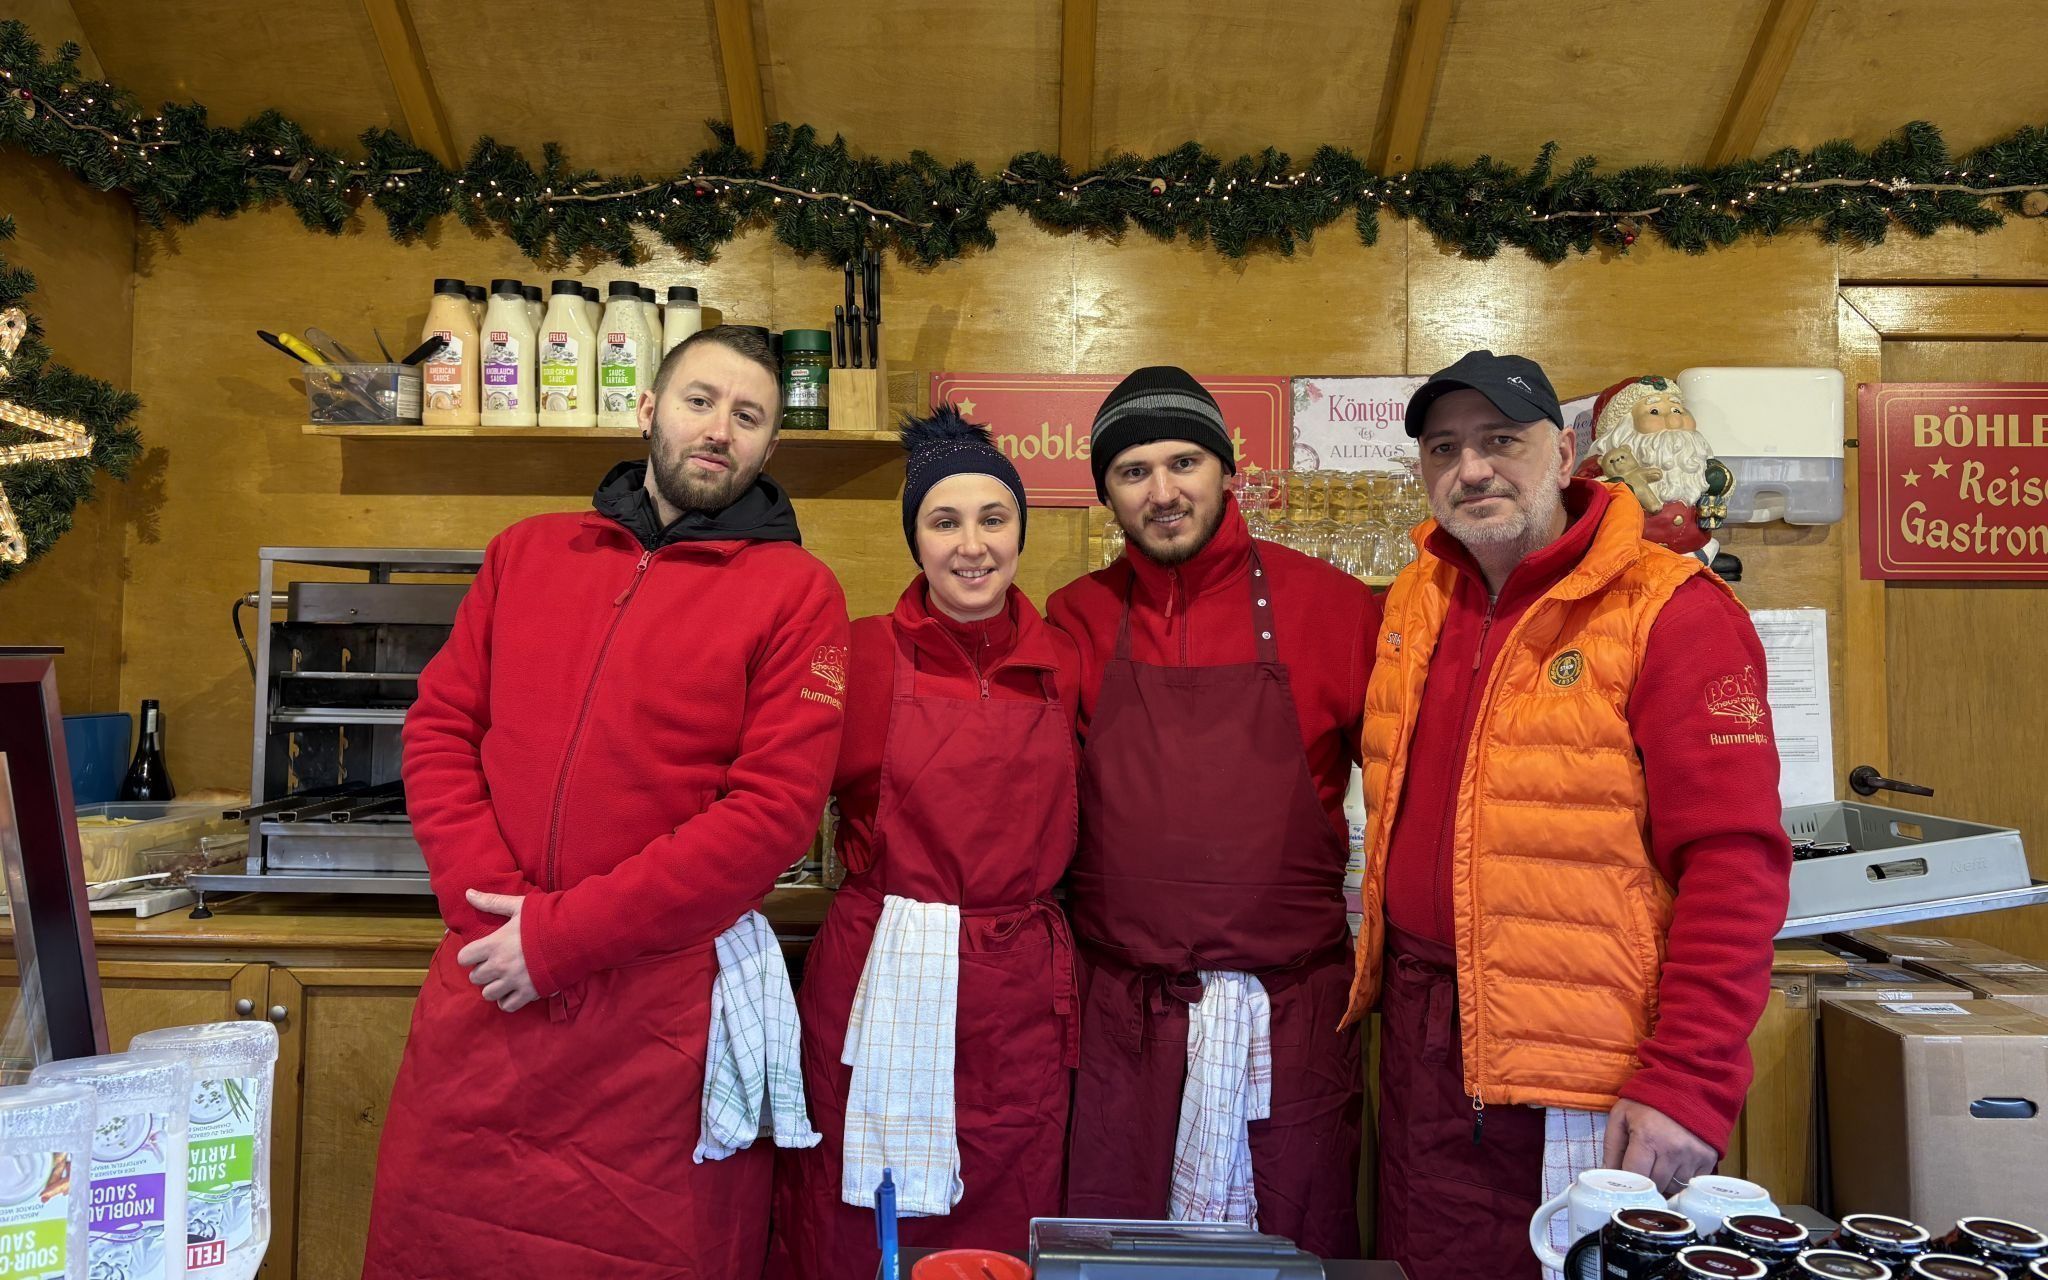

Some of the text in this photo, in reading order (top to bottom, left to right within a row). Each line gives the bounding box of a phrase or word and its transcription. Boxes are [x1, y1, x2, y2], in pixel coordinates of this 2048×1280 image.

[491, 332, 507, 341] FELIX
[549, 333, 567, 342] FELIX
[608, 333, 625, 342] FELIX
[432, 374, 450, 382] SAUCE
[490, 374, 507, 382] SAUCE
[549, 375, 566, 383] SAUCE
[606, 376, 629, 384] TARTARE
[1328, 394, 1405, 429] Königin
[1913, 405, 2048, 448] BÖHLE
[1329, 444, 1406, 458] ALLTAGS
[1959, 459, 2048, 507] Reis
[1901, 500, 2048, 557] Gastron
[189, 1143, 237, 1165] TARTA
[187, 1162, 227, 1183] SAUC
[89, 1197, 155, 1223] KNOBLAU
[0, 1230, 36, 1254] SAU
[0, 1244, 59, 1275] SOUR-C
[188, 1243, 222, 1267] FELI
